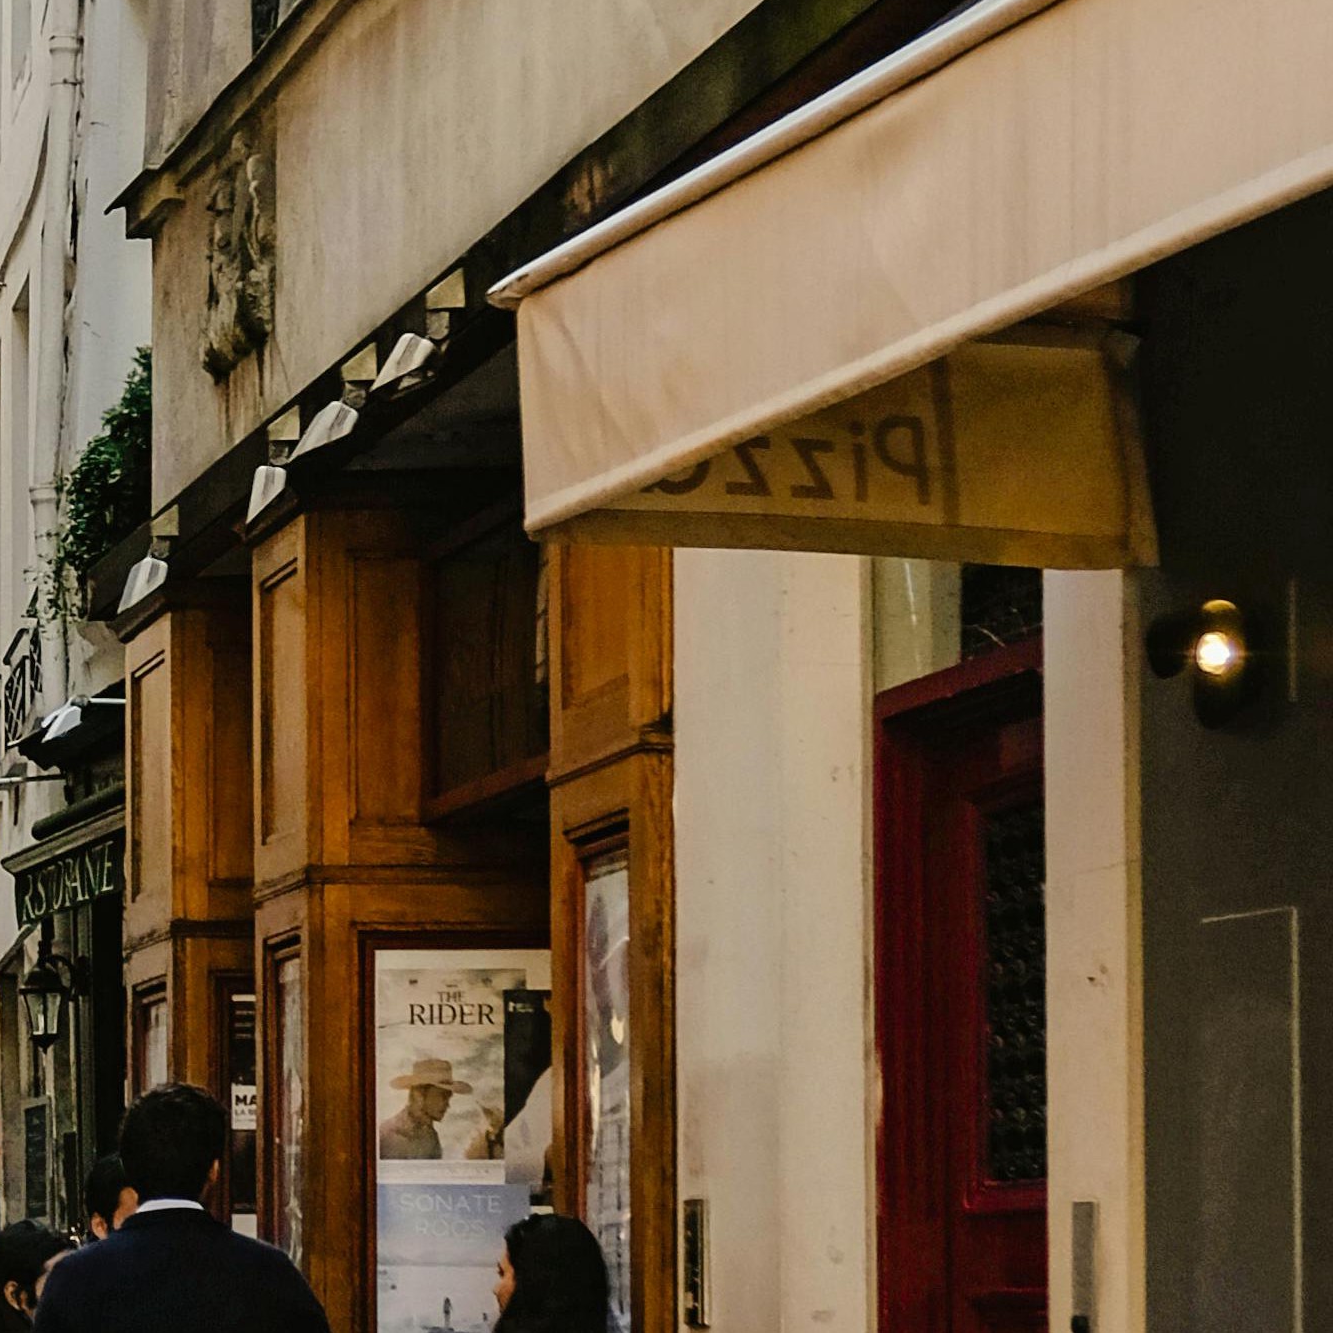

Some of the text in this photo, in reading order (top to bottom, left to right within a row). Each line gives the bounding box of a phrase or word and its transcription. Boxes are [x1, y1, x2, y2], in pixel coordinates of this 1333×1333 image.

[437, 991, 466, 1003] THE
[409, 1003, 495, 1026] RIDER
[398, 1193, 502, 1214] SONATE
